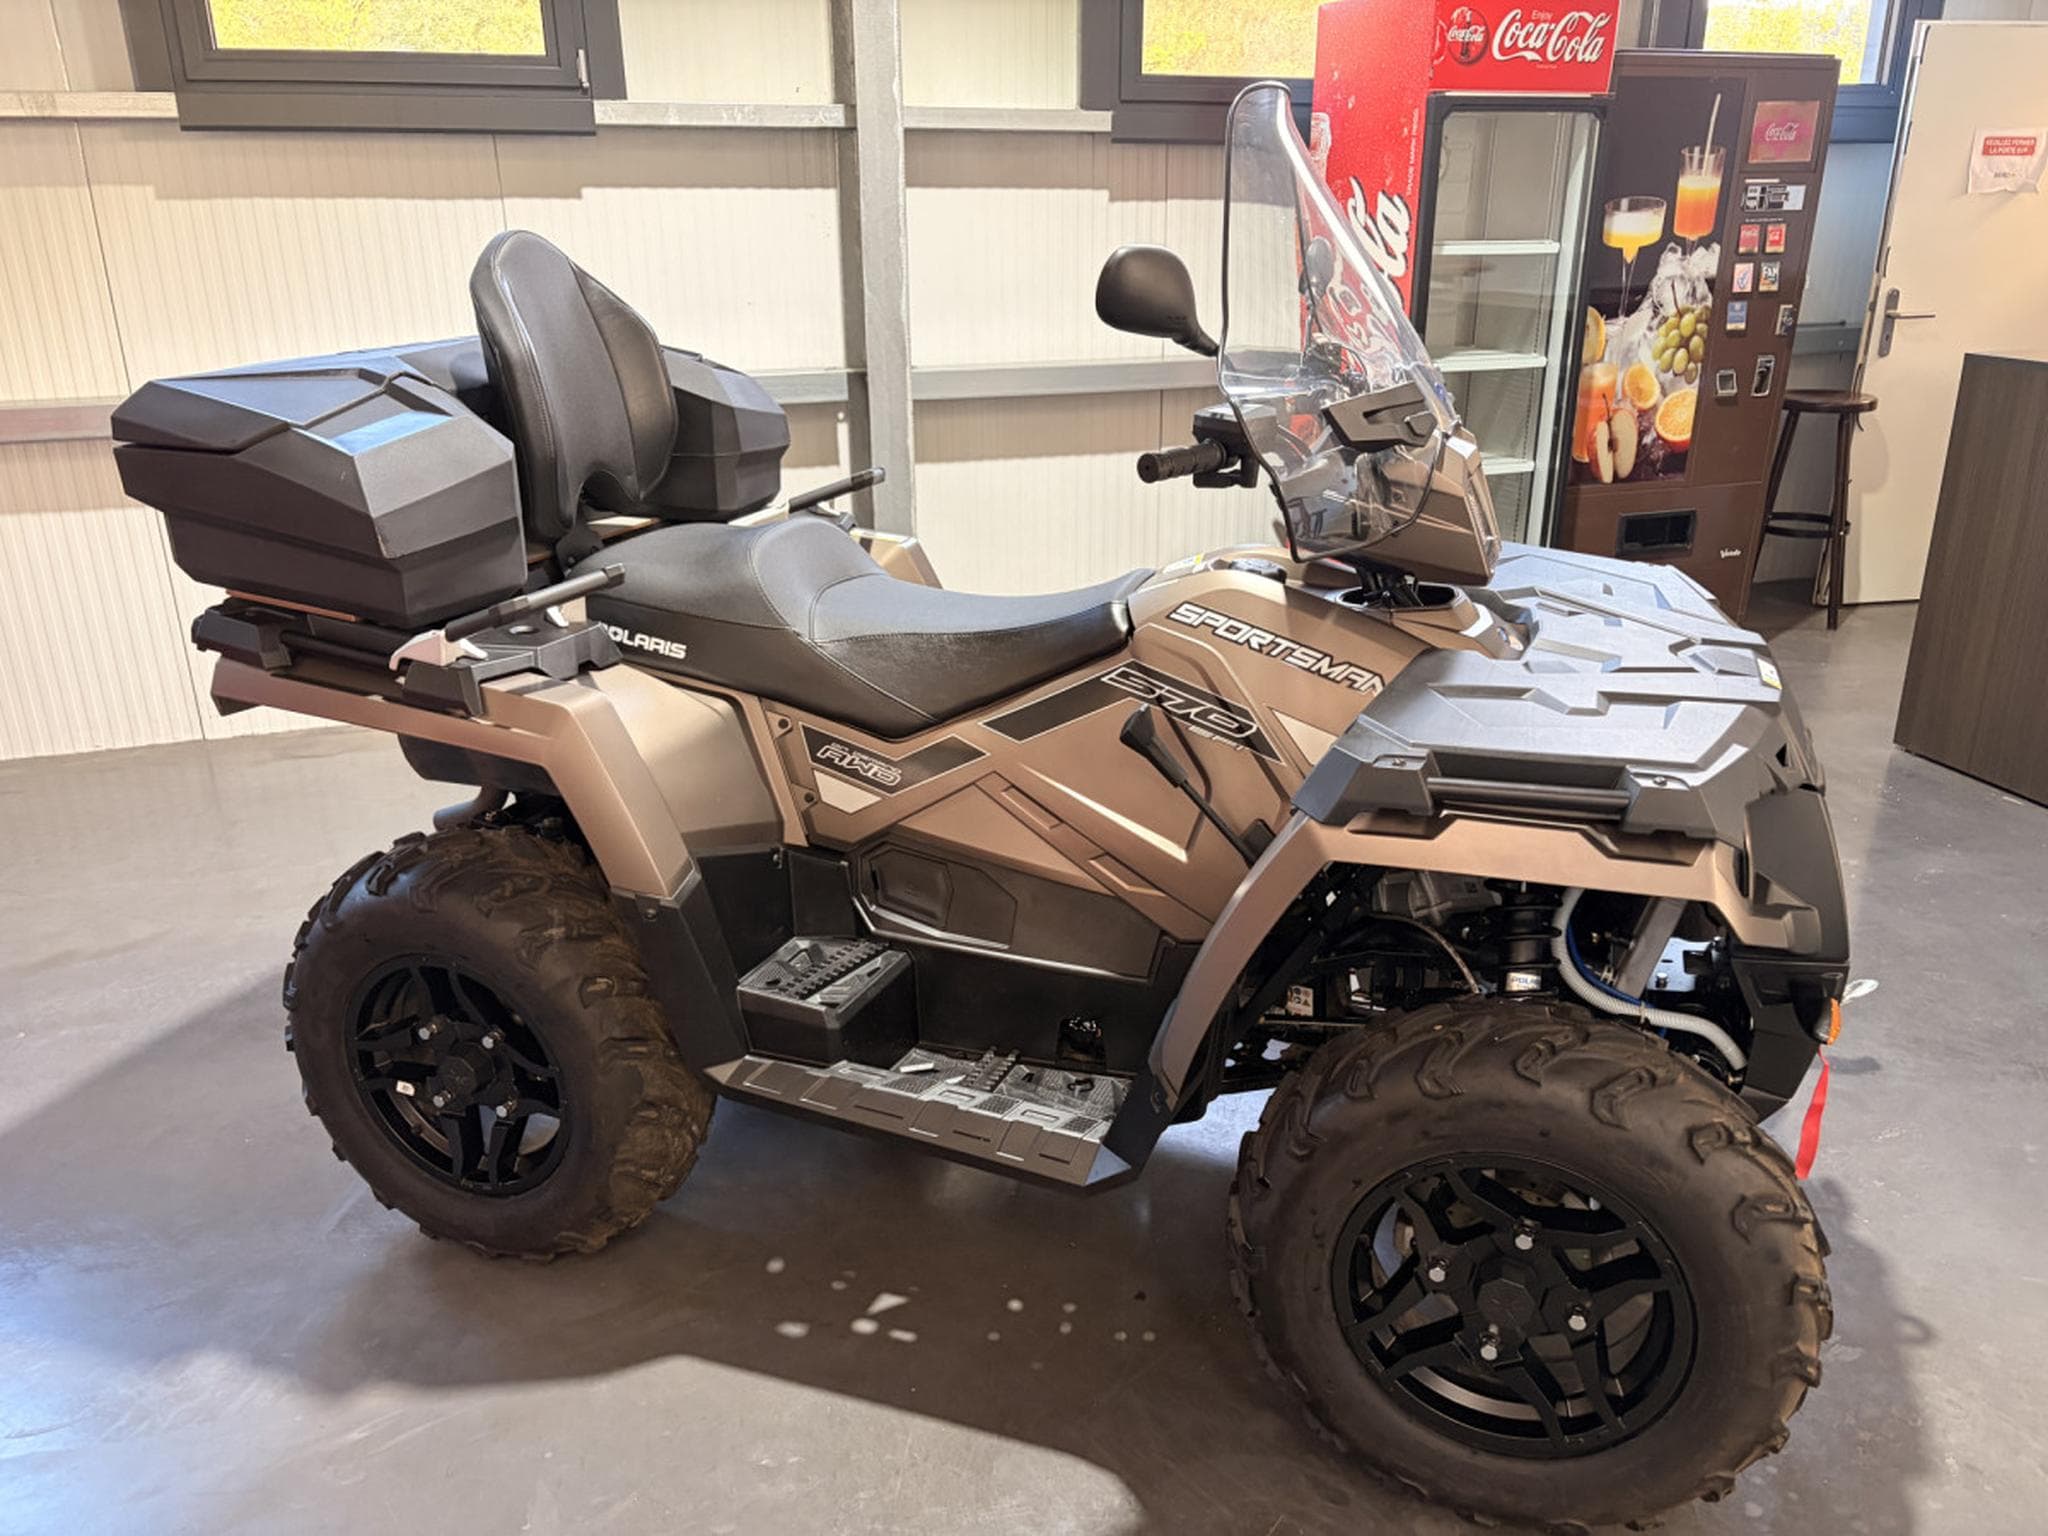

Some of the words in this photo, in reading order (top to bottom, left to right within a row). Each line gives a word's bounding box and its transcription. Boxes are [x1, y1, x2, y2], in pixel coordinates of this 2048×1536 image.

[1531, 9, 1553, 21] Enjoy
[1492, 9, 1611, 63] Coca-Cola
[602, 623, 687, 660] OLARIS
[1168, 601, 1386, 697] SPORTSMAN
[816, 745, 901, 786] AWD
